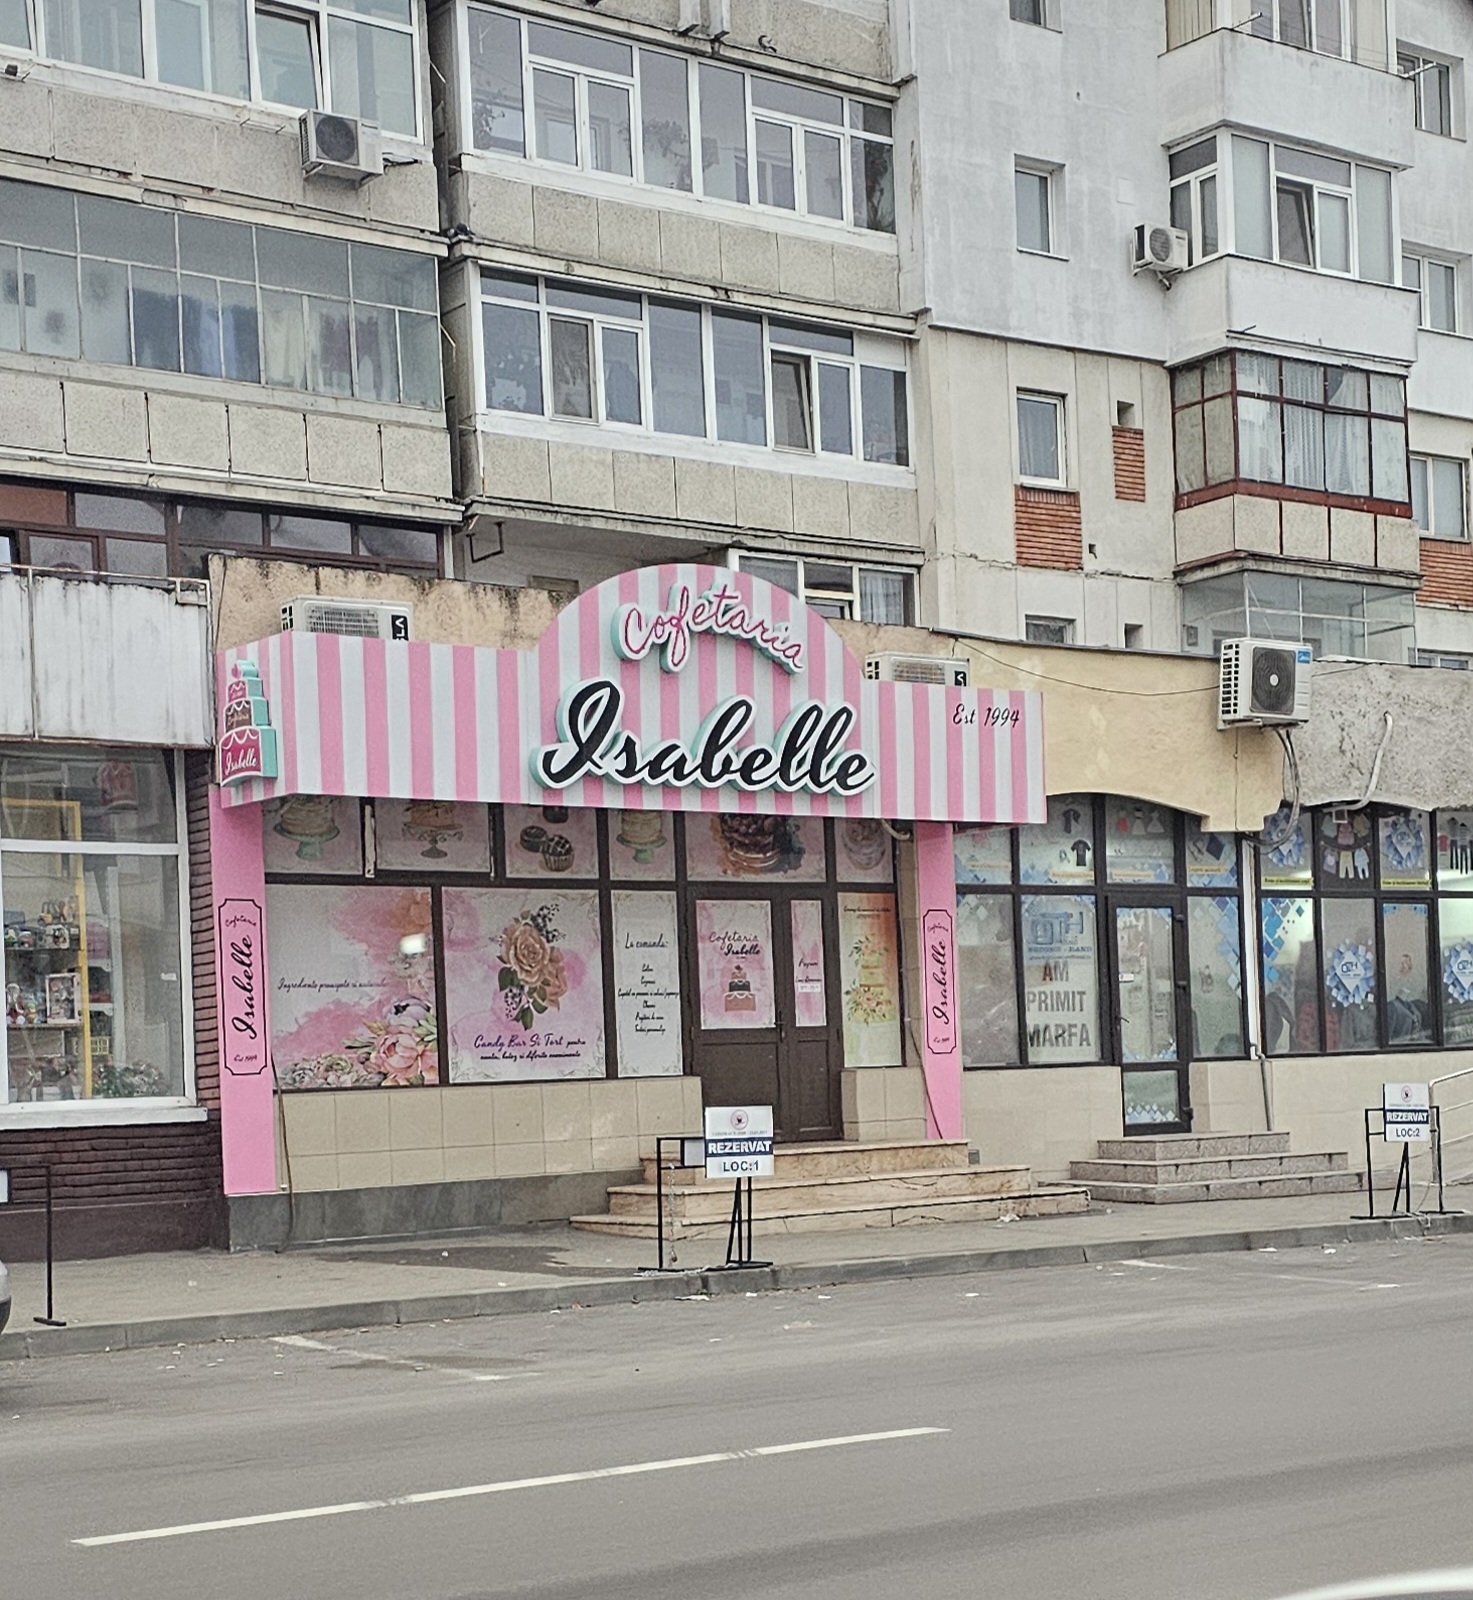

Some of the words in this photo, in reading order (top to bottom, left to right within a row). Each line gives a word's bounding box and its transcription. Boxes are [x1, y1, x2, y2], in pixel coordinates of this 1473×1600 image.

[623, 583, 804, 668] Cofetaria
[952, 703, 976, 725] Est
[983, 706, 1020, 729] 1994
[541, 680, 876, 791] Isabelle
[224, 747, 258, 776] Isabelle
[709, 930, 759, 951] Cofetaria
[724, 943, 761, 956] Isabelle
[1042, 960, 1069, 982] AM
[230, 934, 258, 1040] Isabelle
[931, 941, 950, 1025] Isabelle
[1026, 990, 1087, 1013] PRIMIT
[473, 1034, 505, 1052] Candy
[507, 1034, 527, 1048] Bar
[543, 1032, 564, 1047] Tort
[1028, 1022, 1092, 1048] MARFA
[1386, 1112, 1428, 1122] REZERVAT
[1395, 1128, 1420, 1138] LOC:2
[708, 1141, 772, 1154] REZERVAT
[723, 1160, 759, 1172] LOC:1
